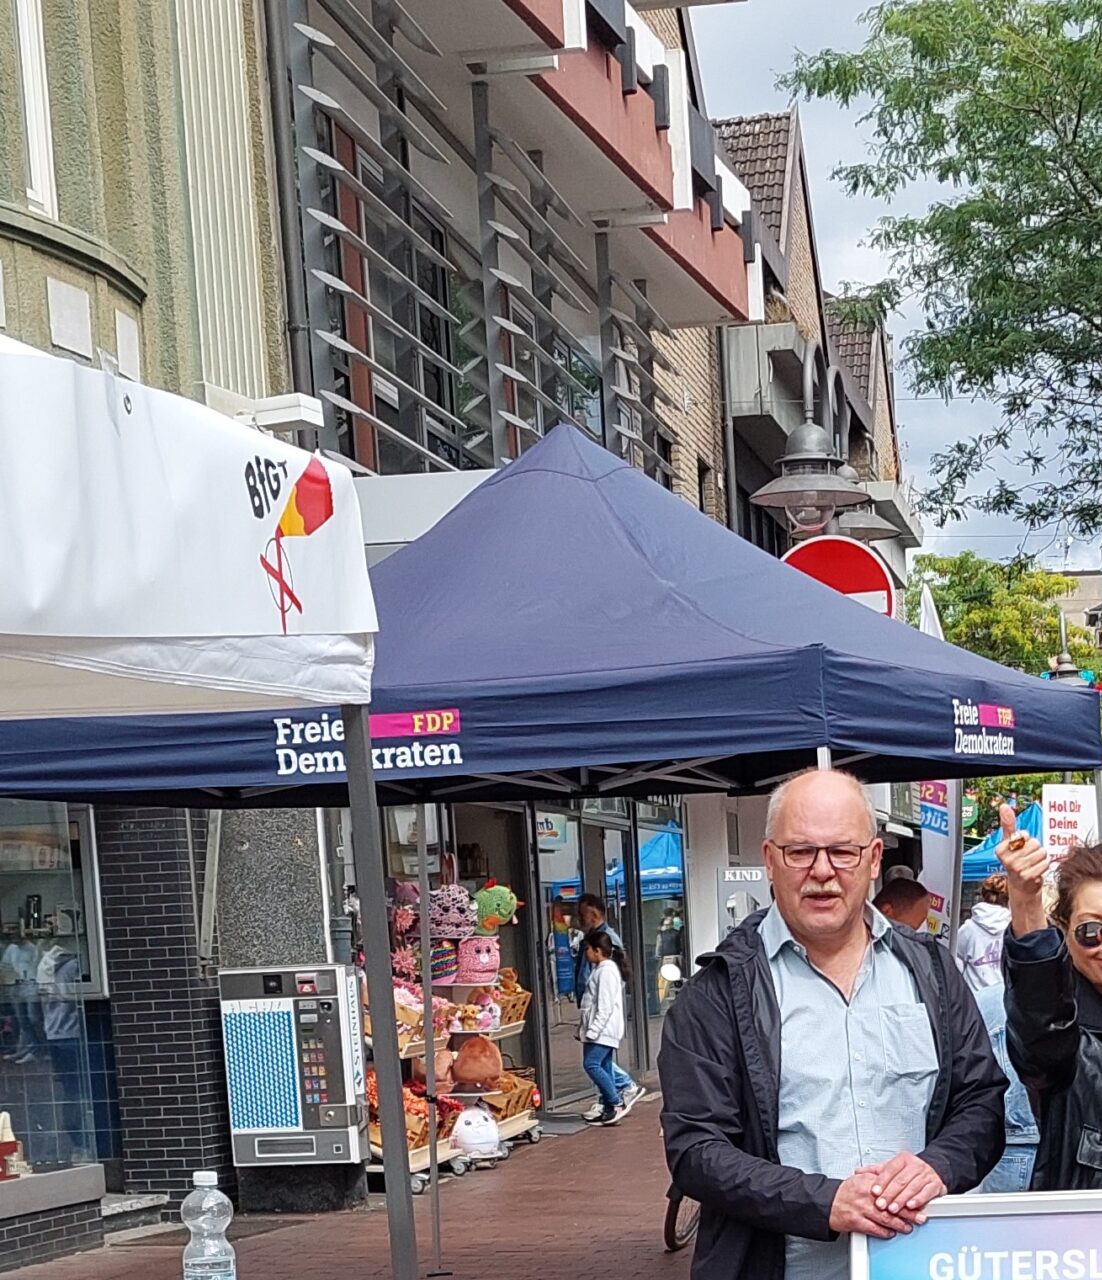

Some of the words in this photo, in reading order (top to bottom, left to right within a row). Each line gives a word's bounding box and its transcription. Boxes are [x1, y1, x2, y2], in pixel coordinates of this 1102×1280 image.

[245, 454, 288, 519] BfGT
[952, 698, 979, 726] Freie
[997, 707, 1013, 726] FDP
[273, 713, 346, 746] Freie
[412, 711, 455, 734] FDP
[954, 727, 1015, 756] Demokraten
[275, 741, 464, 776] Demkraten
[1048, 799, 1068, 813] Hol
[1069, 799, 1082, 813] Dir
[1048, 816, 1078, 830] Deine
[724, 869, 762, 882] KIND
